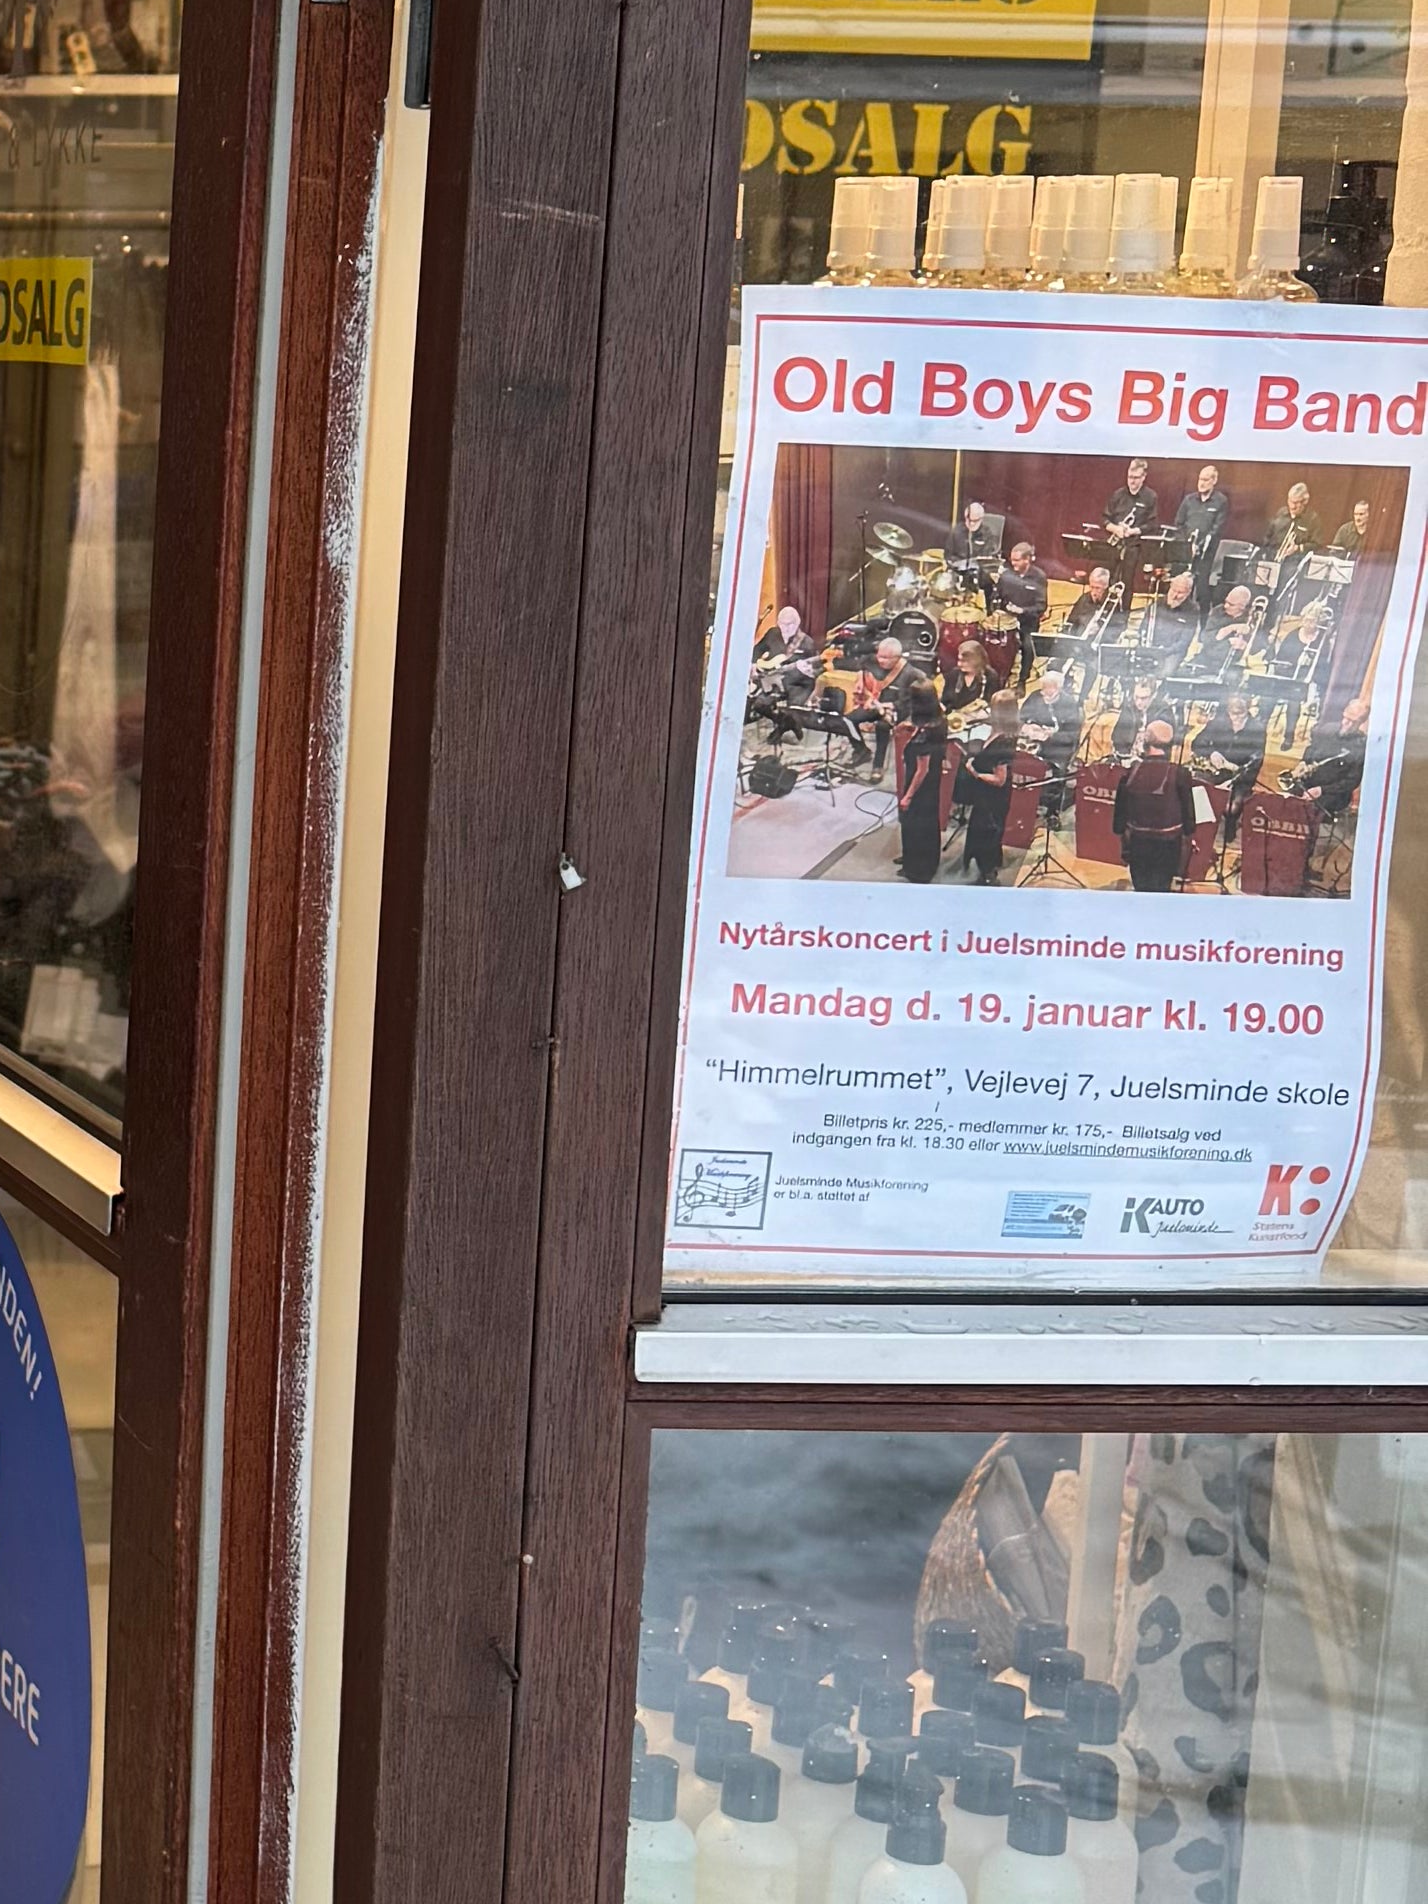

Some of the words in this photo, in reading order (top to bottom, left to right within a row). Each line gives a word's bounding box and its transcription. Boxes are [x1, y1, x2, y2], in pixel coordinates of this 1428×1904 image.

[32, 119, 103, 169] LYKKE
[773, 355, 895, 415] Old
[919, 361, 1093, 434] Boys
[1117, 369, 1229, 443] Big
[1252, 374, 1428, 436] Band
[718, 920, 933, 952] Nytårskoncert
[940, 928, 948, 953] i
[956, 929, 1127, 960] Juelsminde
[1135, 938, 1345, 973] musikforening
[730, 982, 893, 1027] Mandag
[905, 990, 941, 1022] d.
[958, 992, 1011, 1024] 19.
[1021, 994, 1152, 1032] januar
[1163, 999, 1207, 1031] kl.
[1223, 1001, 1325, 1036] 19.00
[964, 1067, 1069, 1102] Vejlevej
[1076, 1073, 1101, 1101] 7,
[1110, 1074, 1269, 1104] Juelsminde
[1276, 1081, 1350, 1107] skole
[792, 1131, 872, 1151] indgangen
[876, 1134, 896, 1148] fra
[899, 1135, 917, 1149] kl.
[923, 1136, 965, 1151] 18.30
[967, 1137, 1001, 1152] eller
[1002, 1138, 1253, 1163] www.juelsmindemusikforening.dk
[823, 1113, 888, 1132] Billetpris
[892, 1116, 910, 1131] kr.
[913, 1117, 956, 1133] 225,-
[958, 1120, 1048, 1136] medlemmer
[1051, 1123, 1069, 1137] kr.
[1075, 1123, 1113, 1139] 175,-
[1121, 1123, 1191, 1144] Billetsalg
[1193, 1127, 1222, 1142] ved
[774, 1175, 843, 1189] Juelsminde
[845, 1177, 929, 1193] Musikforening
[1148, 1198, 1205, 1216] AUTO
